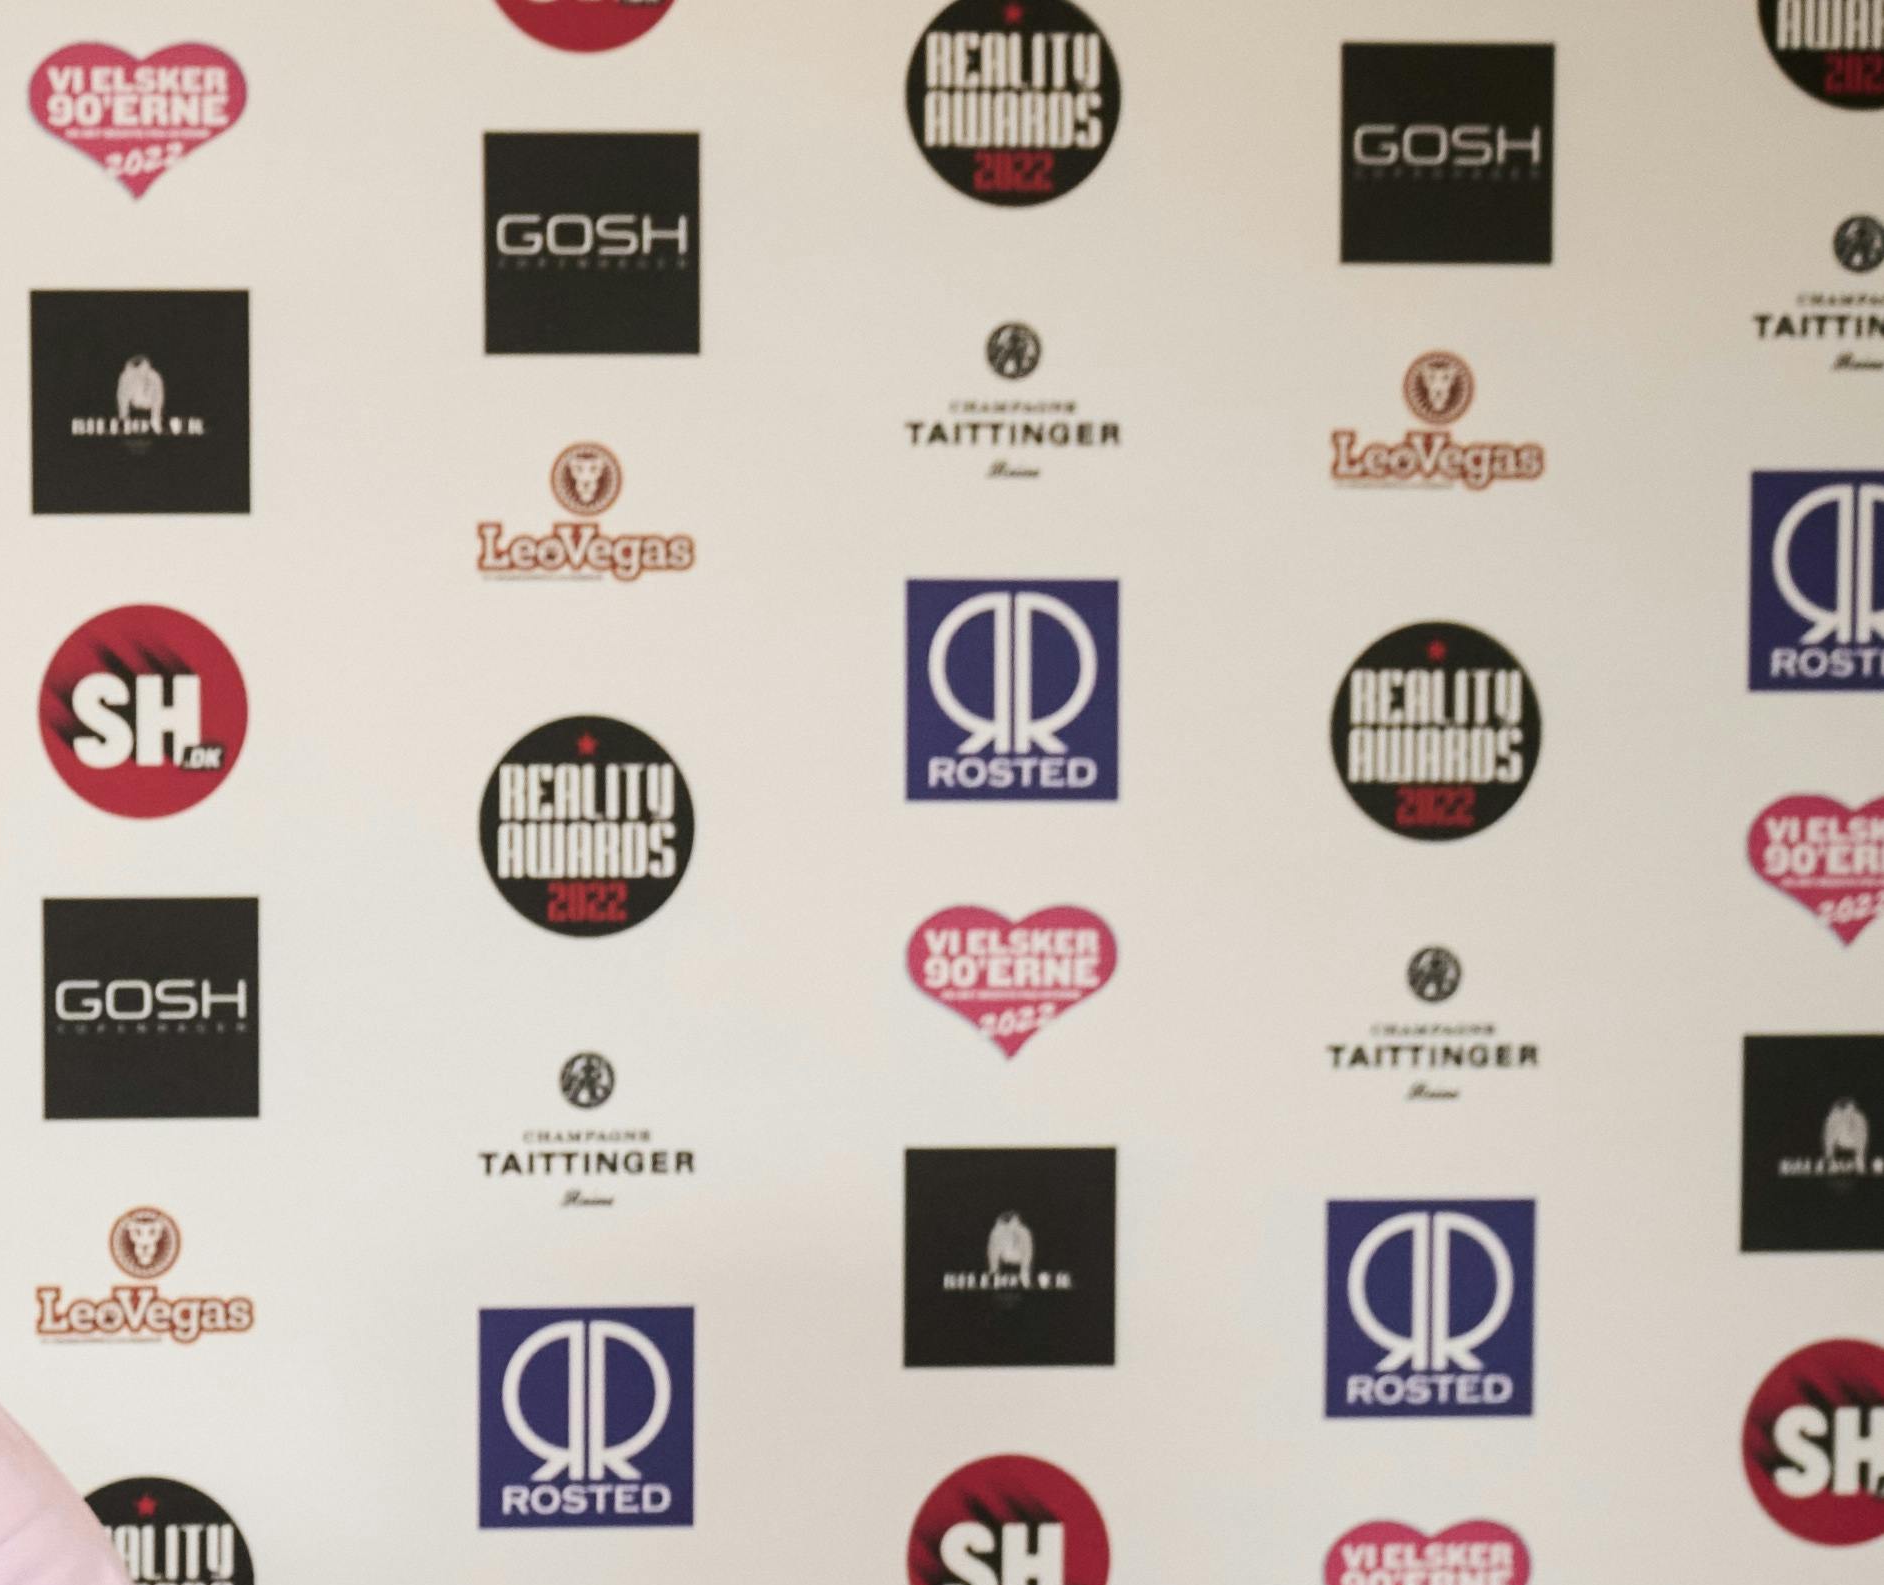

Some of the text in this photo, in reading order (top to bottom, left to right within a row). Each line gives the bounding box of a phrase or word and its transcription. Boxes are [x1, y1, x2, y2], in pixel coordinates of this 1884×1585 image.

[926, 33, 1101, 89] REALITY
[47, 66, 228, 94] VI ELSKER
[47, 96, 229, 127] 90'ERNE
[924, 90, 1102, 148] AWARDS
[106, 141, 185, 179] 2022
[1353, 124, 1541, 166] GOSH
[973, 151, 1054, 191] 2022
[496, 214, 688, 255] GOSH
[1754, 314, 1884, 337] TAITTIN
[950, 401, 1077, 414] CHAMPAGNE
[908, 422, 1120, 446] TAITTINGER
[1329, 431, 1546, 491] LeoVegas
[475, 521, 697, 582] LeoVegas
[1770, 647, 1884, 678] ROST
[1350, 670, 1522, 727] REALITY
[928, 756, 1098, 788] ROSTED
[1348, 726, 1523, 783] AWARDS
[498, 763, 675, 821] REALITY
[1395, 787, 1476, 827] 2022
[1765, 817, 1803, 844] VI
[497, 822, 676, 879] AWARDS
[547, 880, 628, 922] 2022
[924, 929, 1099, 956] VI ELSKER
[924, 957, 1099, 988] 90'ERNE
[55, 979, 247, 1021] GOSH
[980, 1002, 1058, 1039] 2022
[1329, 1044, 1538, 1067] TAITTINGER
[523, 1130, 651, 1143] CHAMPAGNE
[480, 1151, 694, 1174] TAITTINGER
[34, 1285, 256, 1345] LeoVegas
[1346, 1373, 1513, 1405] ROSTED
[502, 1484, 672, 1515] ROSTED
[1342, 1541, 1513, 1569] VI ELSKER
